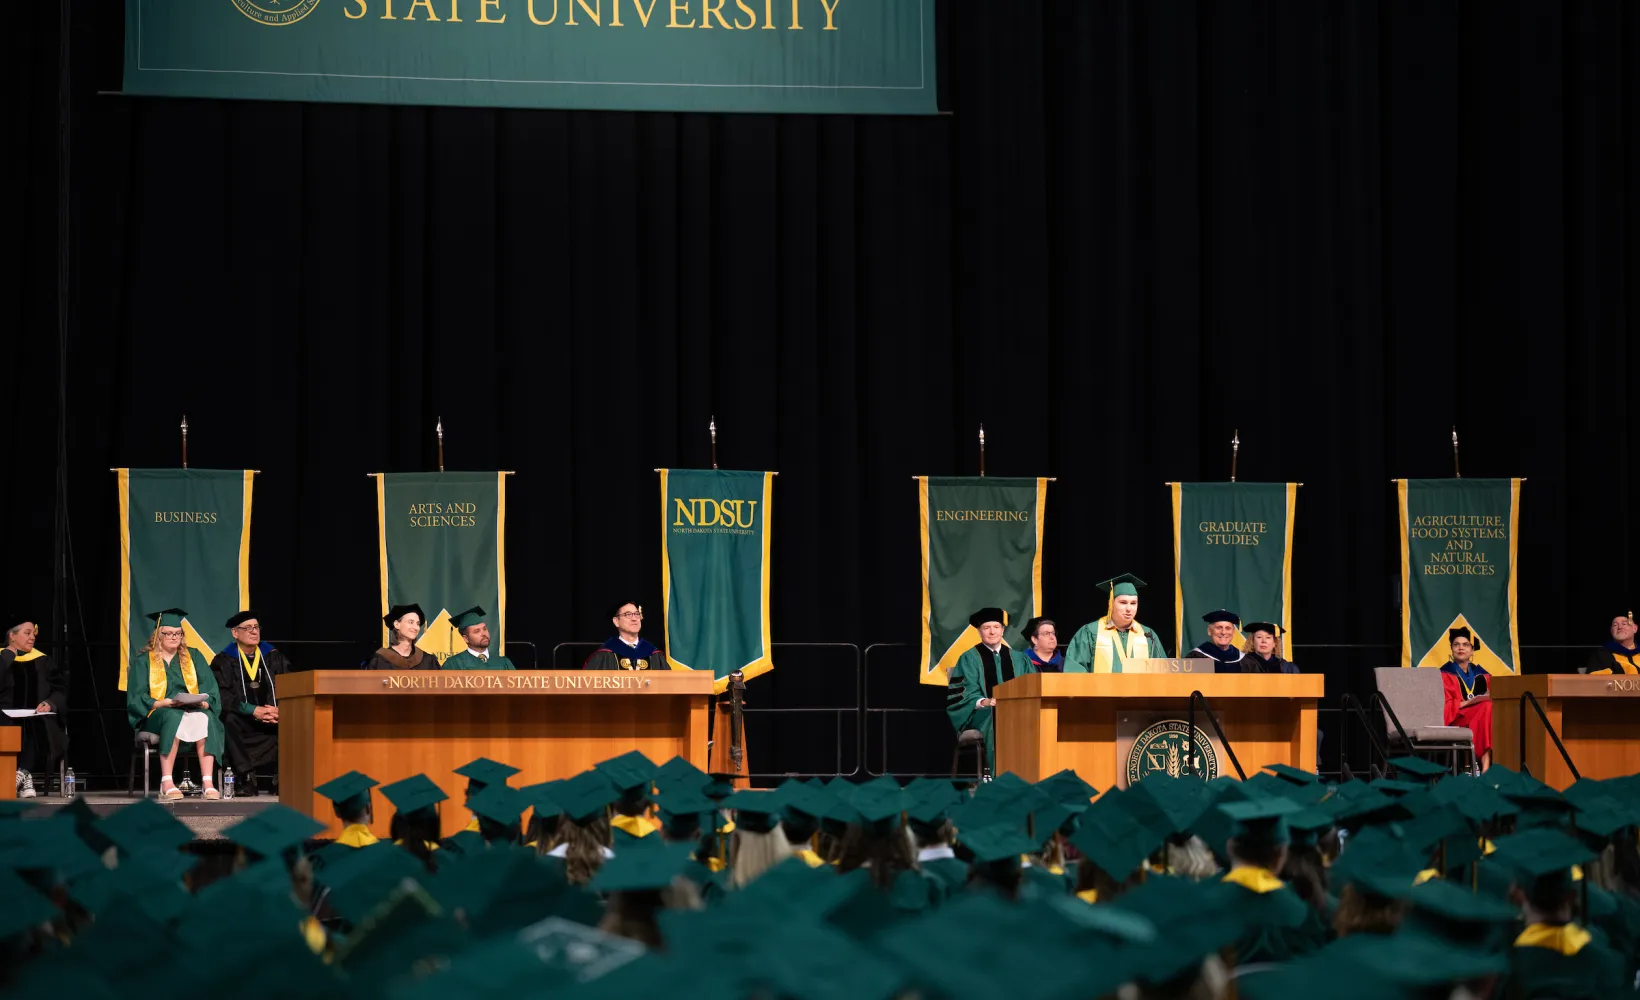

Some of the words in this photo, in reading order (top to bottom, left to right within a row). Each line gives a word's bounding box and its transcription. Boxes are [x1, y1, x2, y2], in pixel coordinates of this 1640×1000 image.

[264, 14, 279, 22] and
[281, 4, 309, 22] Applied
[528, 0, 840, 30] UNIVERSITY
[408, 503, 443, 514] ARTS
[446, 502, 477, 514] AND
[673, 498, 757, 528] NDSU
[154, 511, 217, 524] BUSINESS
[410, 515, 476, 527] SCIENCES
[936, 510, 1029, 522] ENGINEERING
[1413, 515, 1505, 527] AGRICULTURE,
[1199, 521, 1268, 533] GRADUATE
[1411, 528, 1449, 539] FOOD
[1451, 527, 1507, 540] SYSTEMS,
[1206, 534, 1260, 546] STUDIES
[1445, 540, 1473, 550] AND
[1430, 552, 1489, 563] NATURAL
[1423, 564, 1495, 575] RESOURCES
[1144, 660, 1193, 672] NDSU
[389, 675, 439, 689] NORTH
[444, 675, 503, 689] DAKOTA
[507, 675, 550, 689] STATE
[554, 675, 645, 689] UNIVERSITY
[1130, 744, 1143, 771] NORTH
[1140, 724, 1167, 745] DAKOTA
